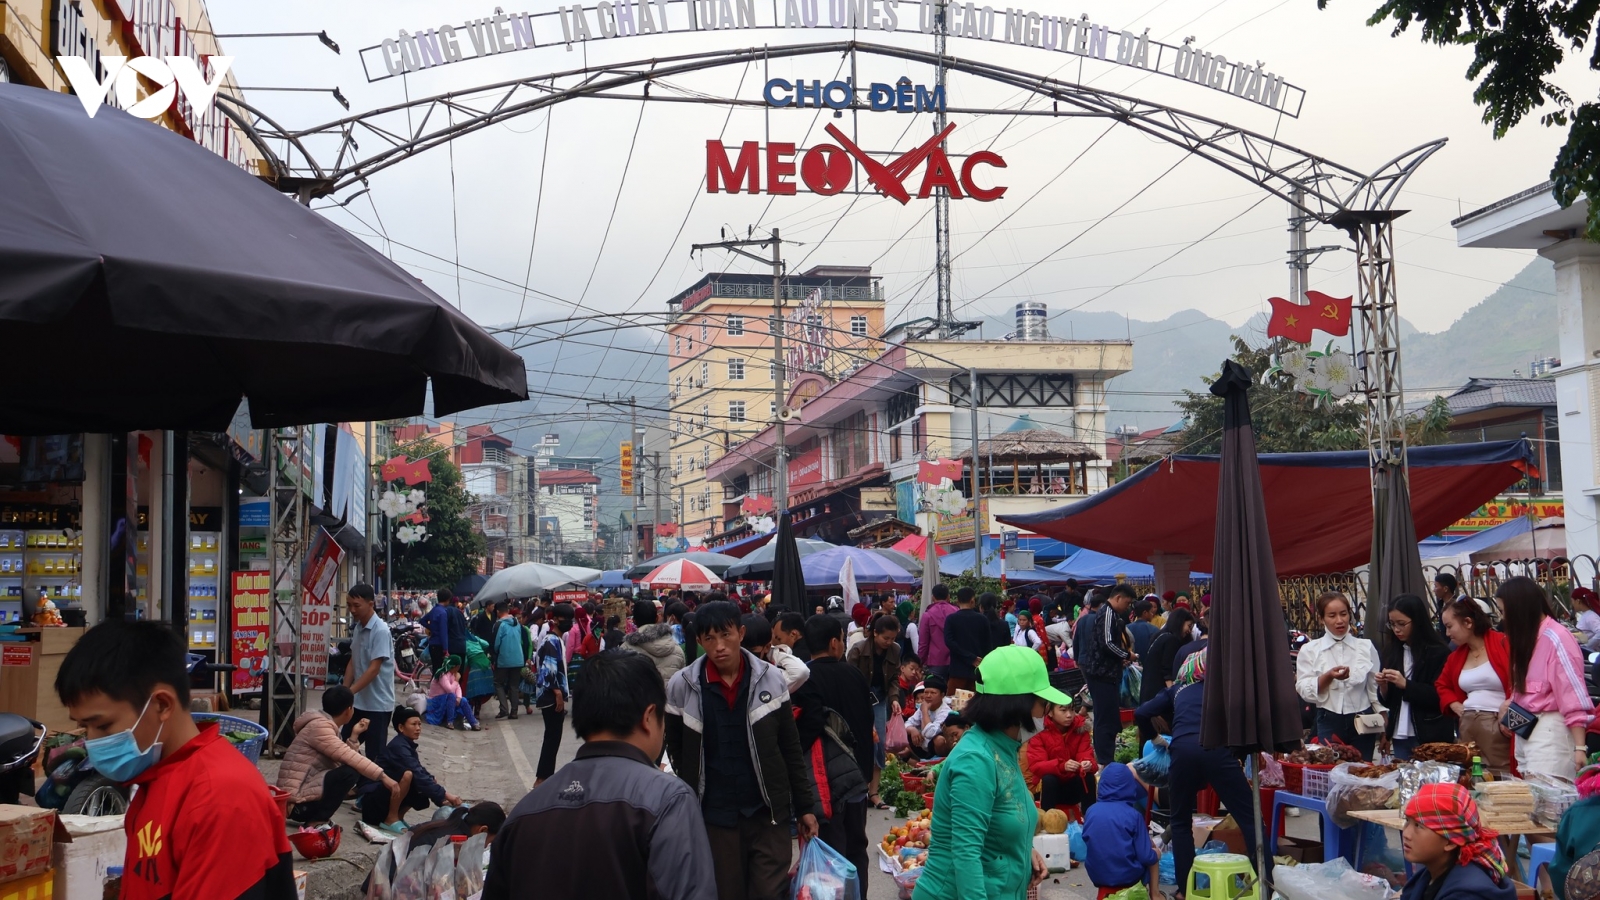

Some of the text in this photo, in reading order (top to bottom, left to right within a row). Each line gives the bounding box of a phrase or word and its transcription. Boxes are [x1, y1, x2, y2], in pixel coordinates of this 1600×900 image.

[381, 28, 462, 76] CÔNG
[465, 7, 536, 58] VIÊN
[946, 2, 995, 41] CAO
[1005, 7, 1109, 60] NGUYÊN
[1116, 27, 1151, 69] ĐÁ
[1233, 59, 1284, 110] VĂN
[763, 76, 947, 118] CHỢ ĐÊM
[1509, 711, 1525, 724] PRADA
